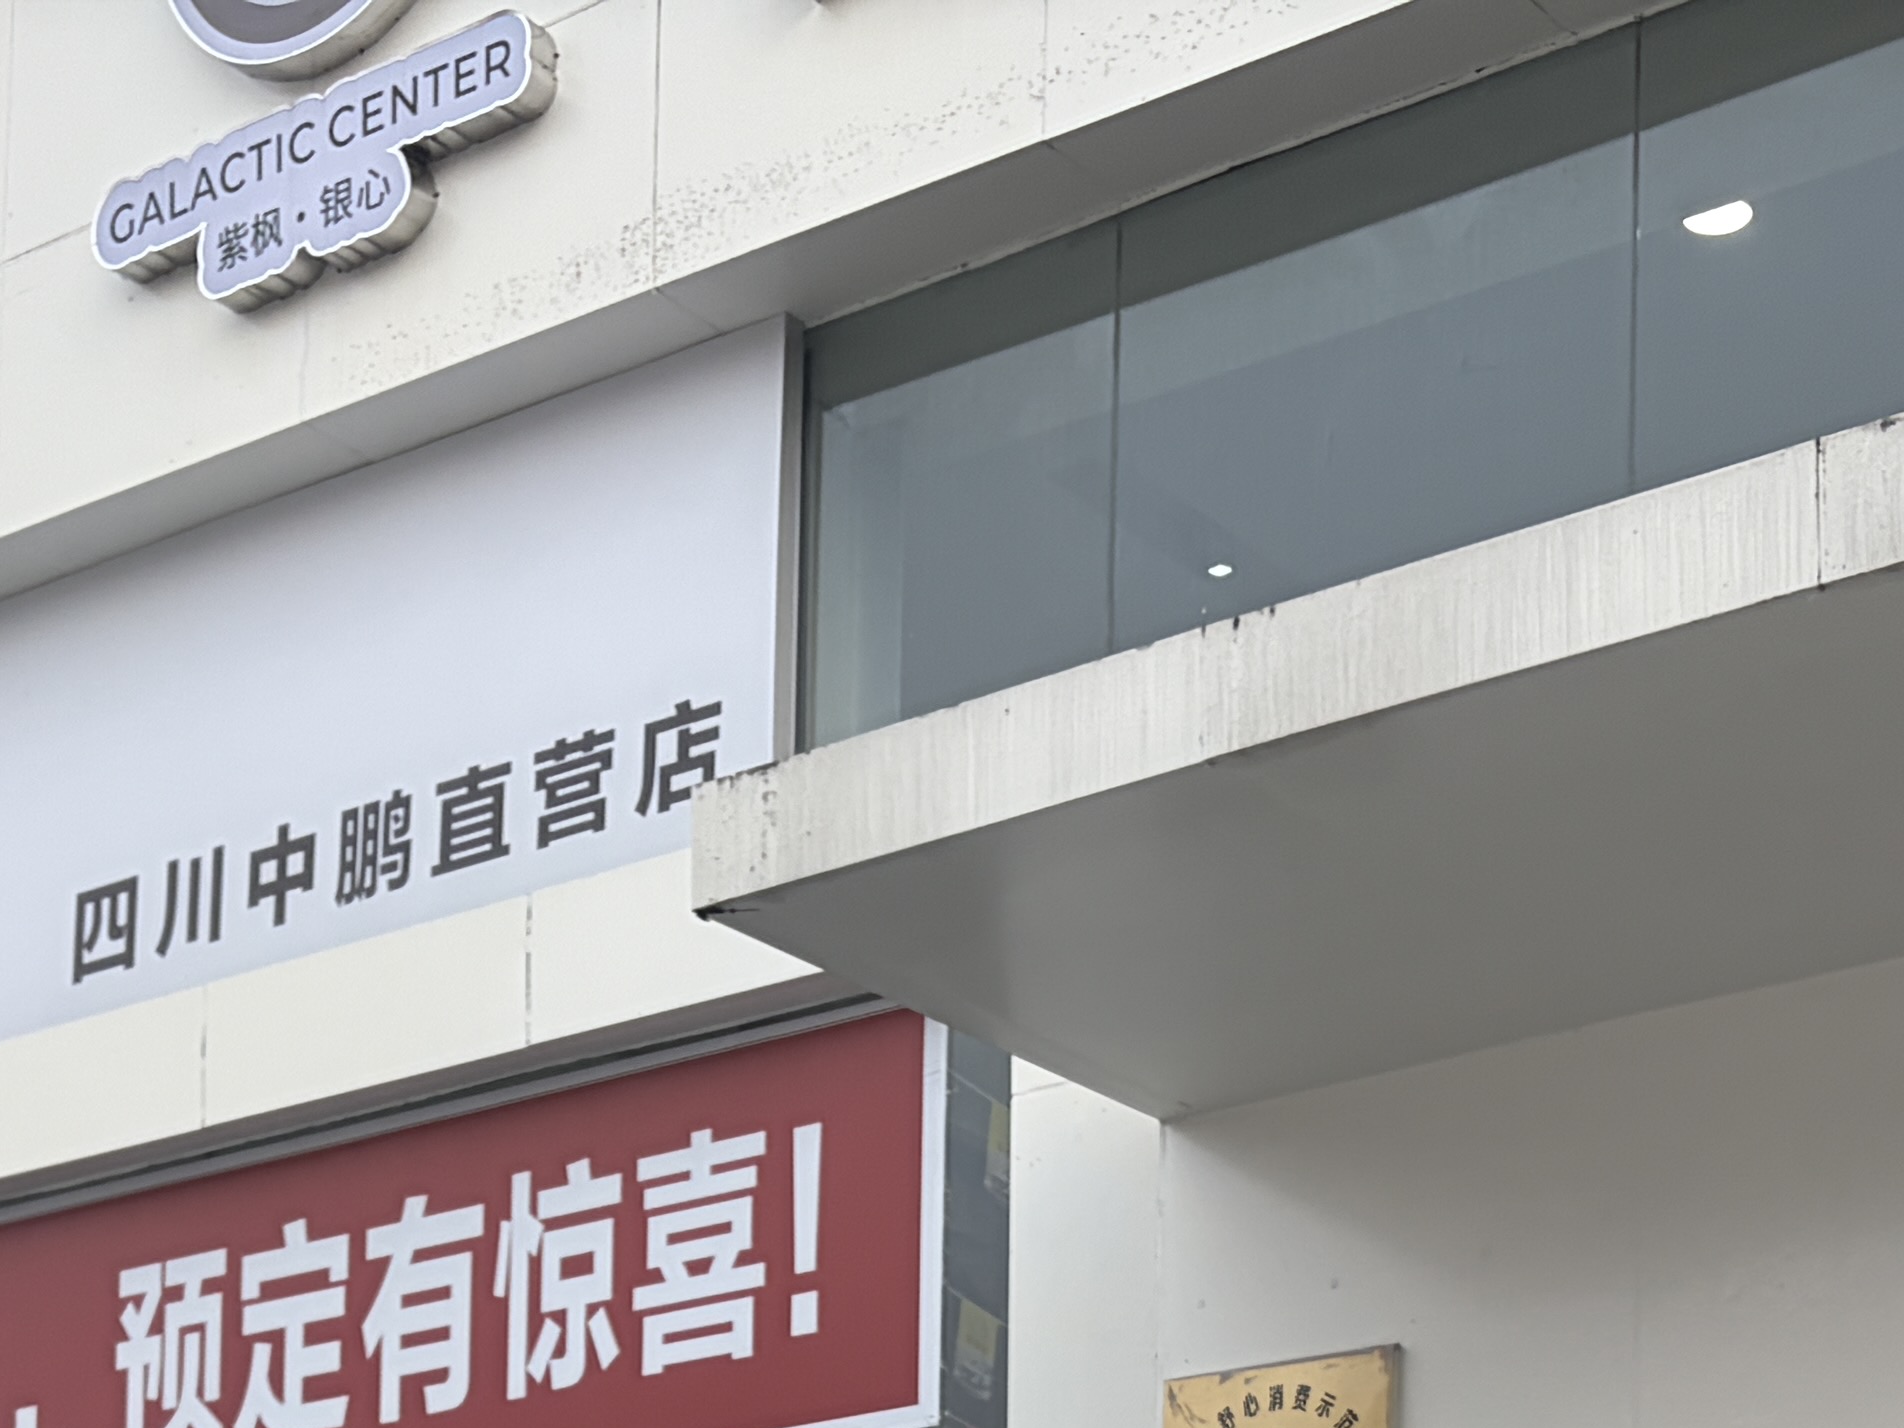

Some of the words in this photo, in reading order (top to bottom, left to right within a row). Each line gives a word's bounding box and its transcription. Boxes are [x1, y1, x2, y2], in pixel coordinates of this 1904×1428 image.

[107, 120, 318, 249] GALACTIC
[326, 38, 514, 150] CENTER
[72, 699, 724, 986] 四川中鹏直营店
